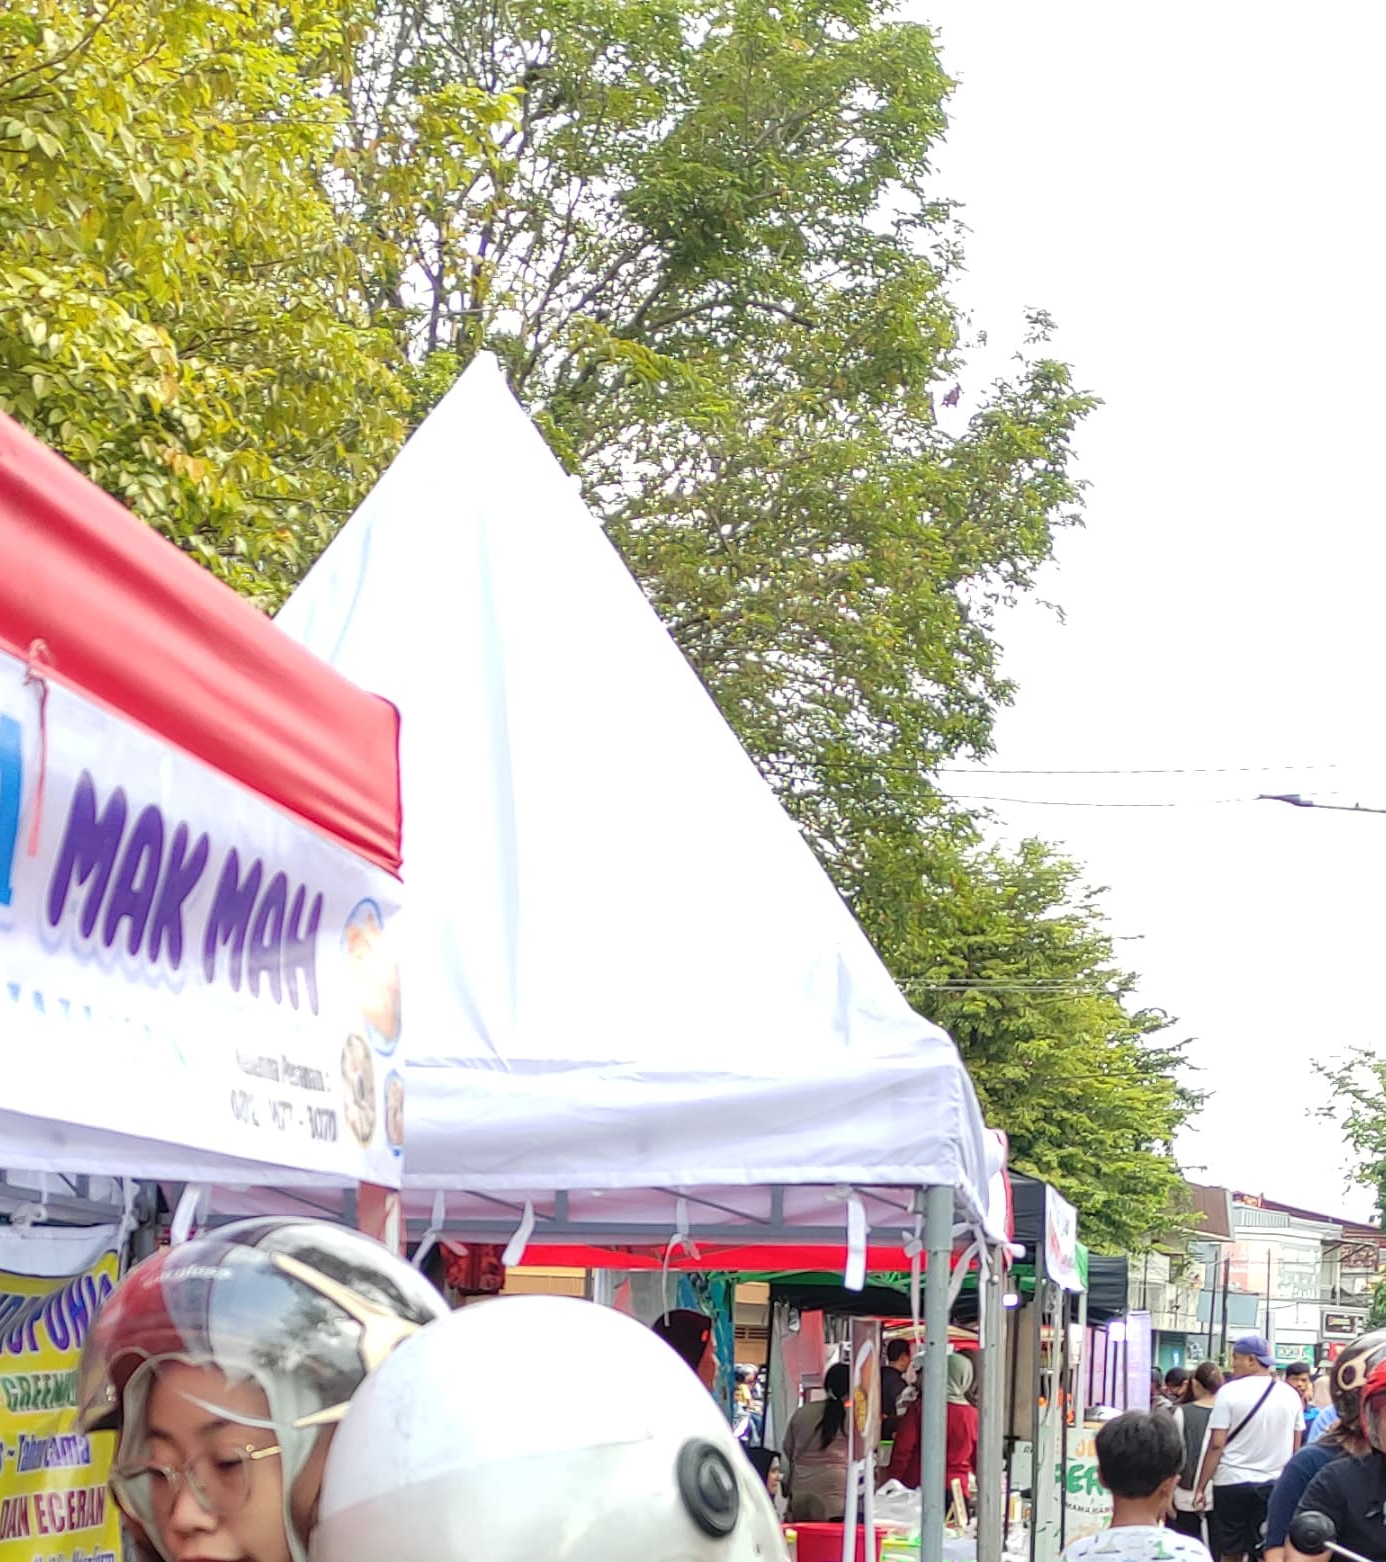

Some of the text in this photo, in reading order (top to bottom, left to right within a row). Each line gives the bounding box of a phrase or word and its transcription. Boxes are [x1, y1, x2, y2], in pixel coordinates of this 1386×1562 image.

[47, 768, 210, 970] MAK
[202, 845, 324, 1017] MAH
[34, 1486, 105, 1534] ECERAN
